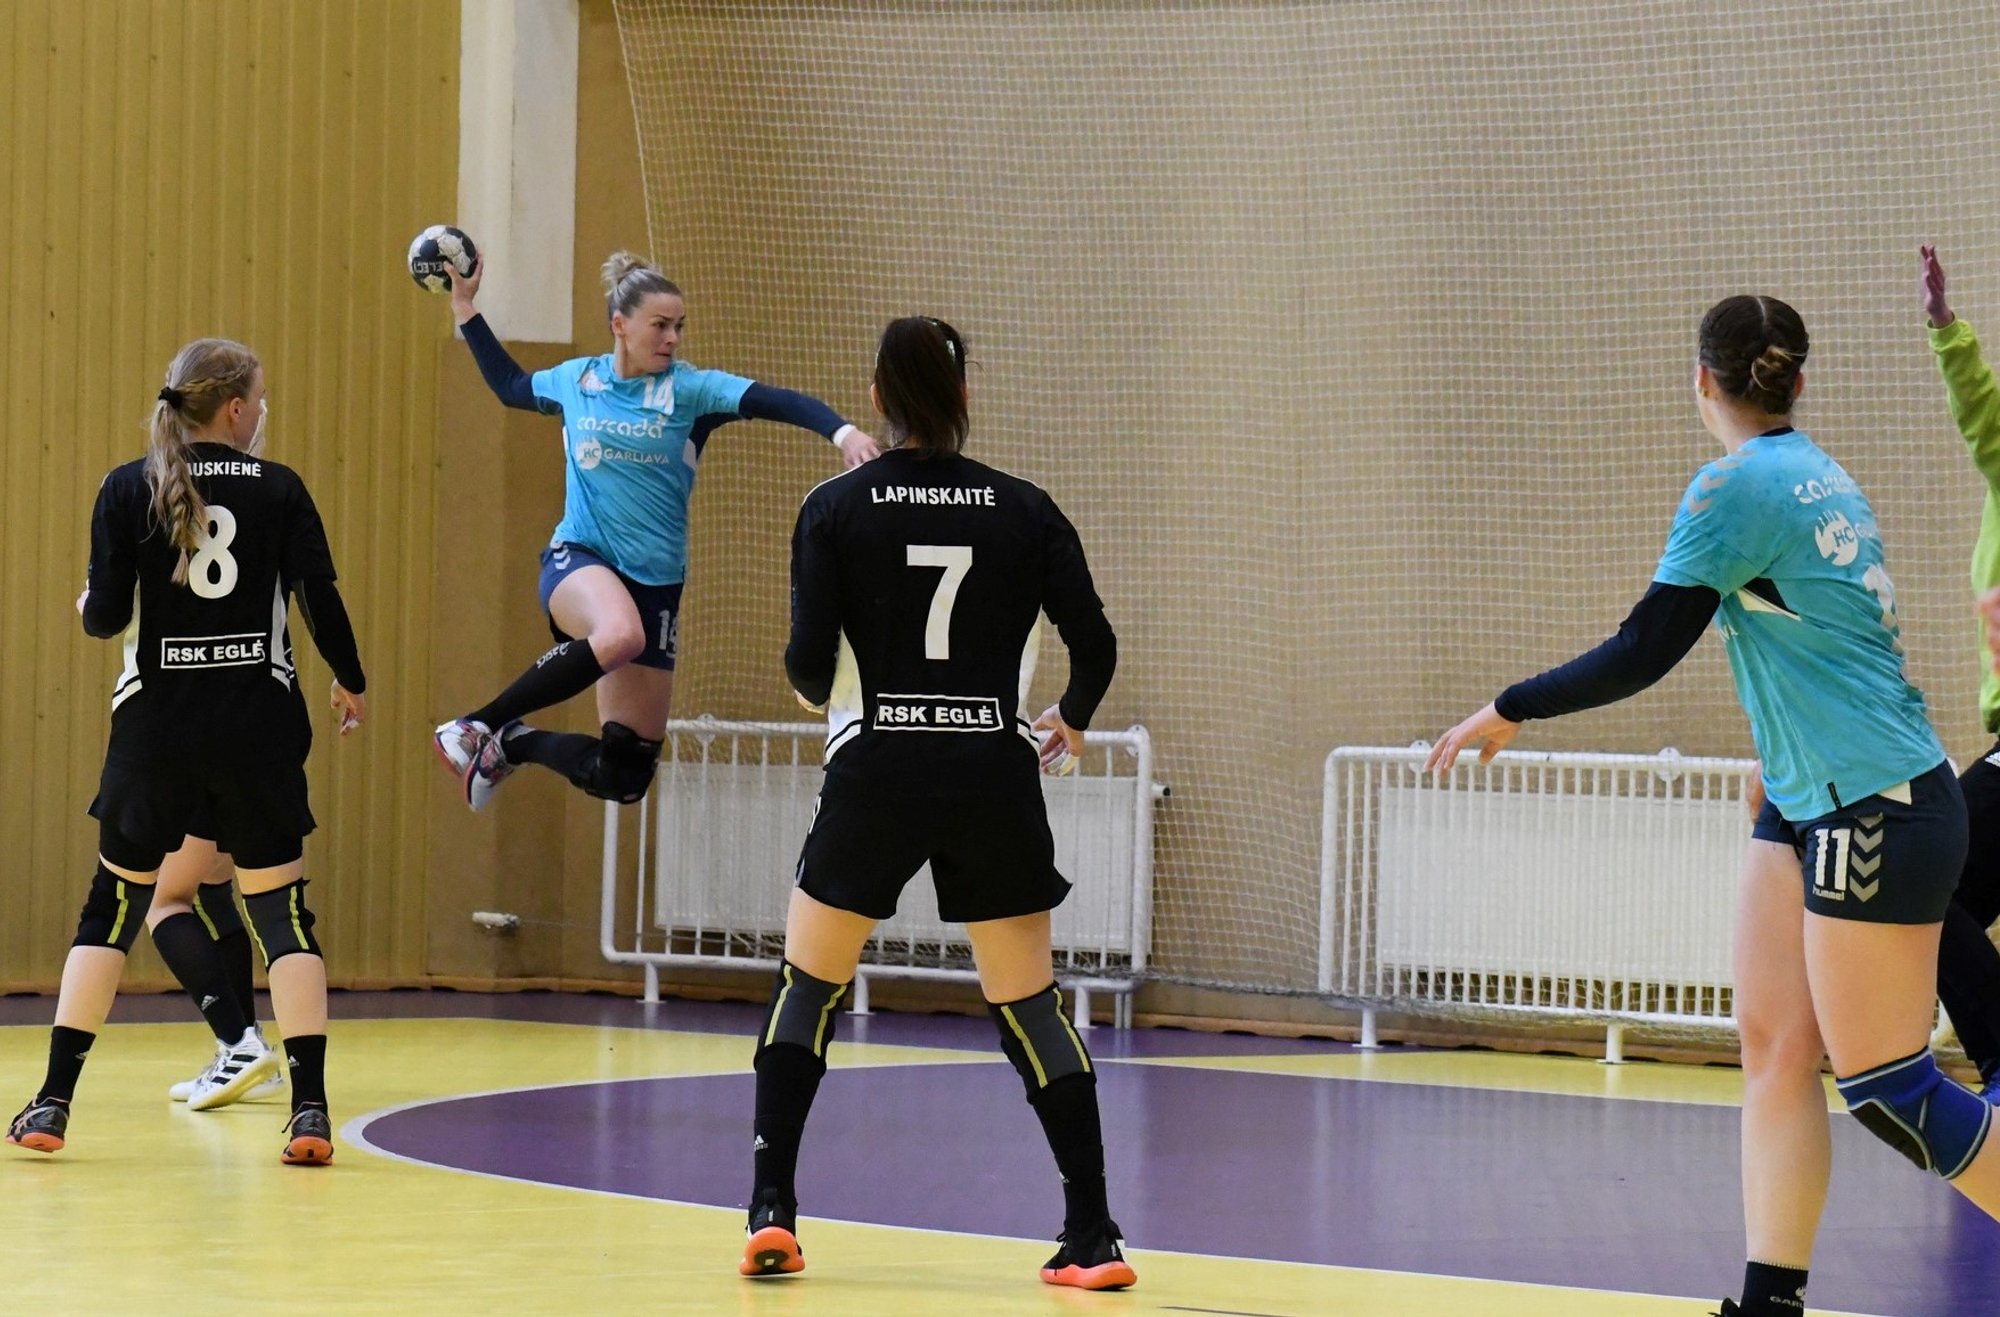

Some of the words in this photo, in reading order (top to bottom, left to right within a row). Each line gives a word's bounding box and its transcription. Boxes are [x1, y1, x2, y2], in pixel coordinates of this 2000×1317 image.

[642, 374, 675, 416] 14
[583, 447, 600, 459] HC
[603, 448, 670, 465] GARLIAVA
[871, 485, 996, 506] LAPINSKAITĖ
[1833, 526, 1855, 547] HC
[189, 505, 239, 599] 8
[906, 544, 973, 659] 7
[167, 646, 207, 662] RSK
[213, 639, 264, 660] EGLĖ
[879, 705, 927, 723] RSK
[935, 705, 993, 725] EGLĖ
[1815, 828, 1851, 891] 11
